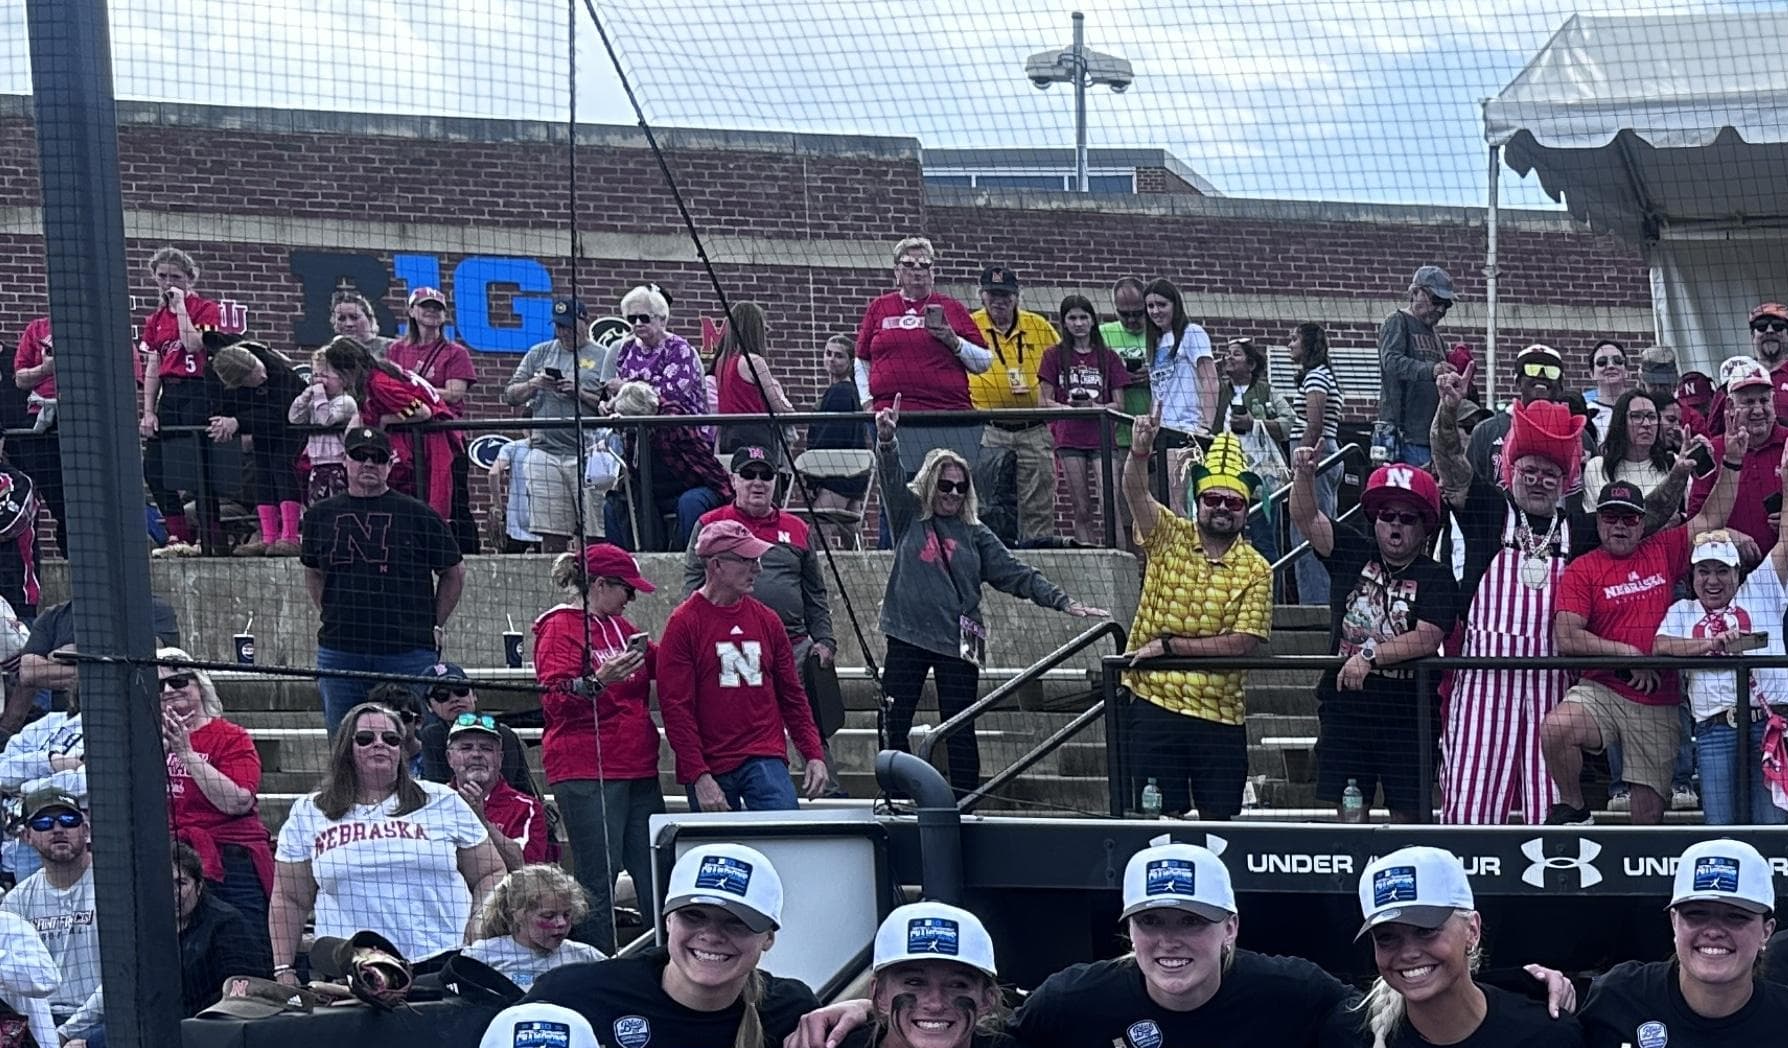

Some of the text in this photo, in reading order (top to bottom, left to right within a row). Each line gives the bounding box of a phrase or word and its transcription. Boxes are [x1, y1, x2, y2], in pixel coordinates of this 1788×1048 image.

[185, 355, 196, 373] 5
[1683, 382, 1696, 395] N
[1385, 469, 1413, 490] N
[330, 513, 392, 565] N
[778, 531, 791, 543] N
[1603, 573, 1666, 599] NEBRASKA
[716, 641, 763, 688] N
[315, 820, 430, 859] NEBRASKA
[1247, 854, 1353, 875] UNDER
[229, 979, 250, 998] N
